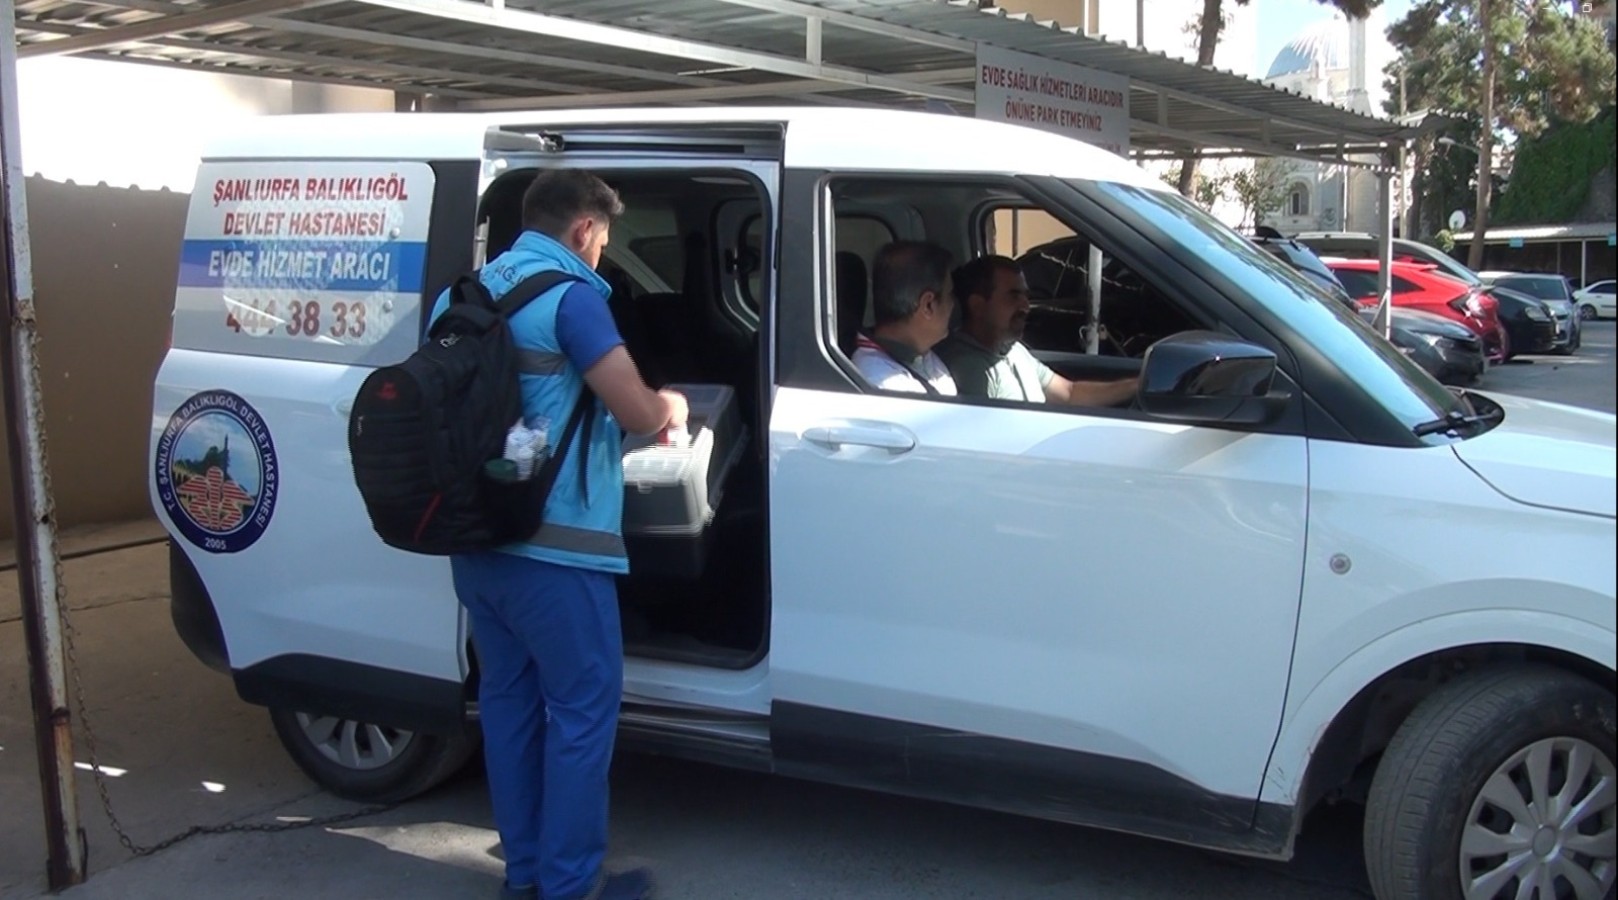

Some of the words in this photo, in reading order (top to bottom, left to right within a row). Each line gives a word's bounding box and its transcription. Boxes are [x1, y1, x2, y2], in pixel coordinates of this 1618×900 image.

[982, 65, 1005, 87] EVDE
[1007, 67, 1039, 93] SAĞLIK
[1040, 72, 1088, 101] HİZMETLERİ
[1088, 86, 1124, 109] ARACIDIR
[1005, 95, 1035, 122] ÖNÜNE
[1037, 105, 1059, 126] PARK
[1060, 109, 1102, 132] ETMEYİNİZ
[213, 178, 300, 207] ŞANLIURFA
[304, 172, 408, 201] BALIKLIGÖL
[223, 212, 285, 236] DEVLET
[288, 208, 386, 236] HASTANESİ
[208, 250, 254, 278] EVDE
[257, 244, 328, 279] HİZMET
[330, 252, 390, 281] ARACI
[285, 300, 320, 337] 38
[330, 302, 366, 338] 33
[182, 394, 239, 418] BALIKLIGÖL
[239, 406, 271, 451] DEVLET
[205, 536, 227, 550] 2005
